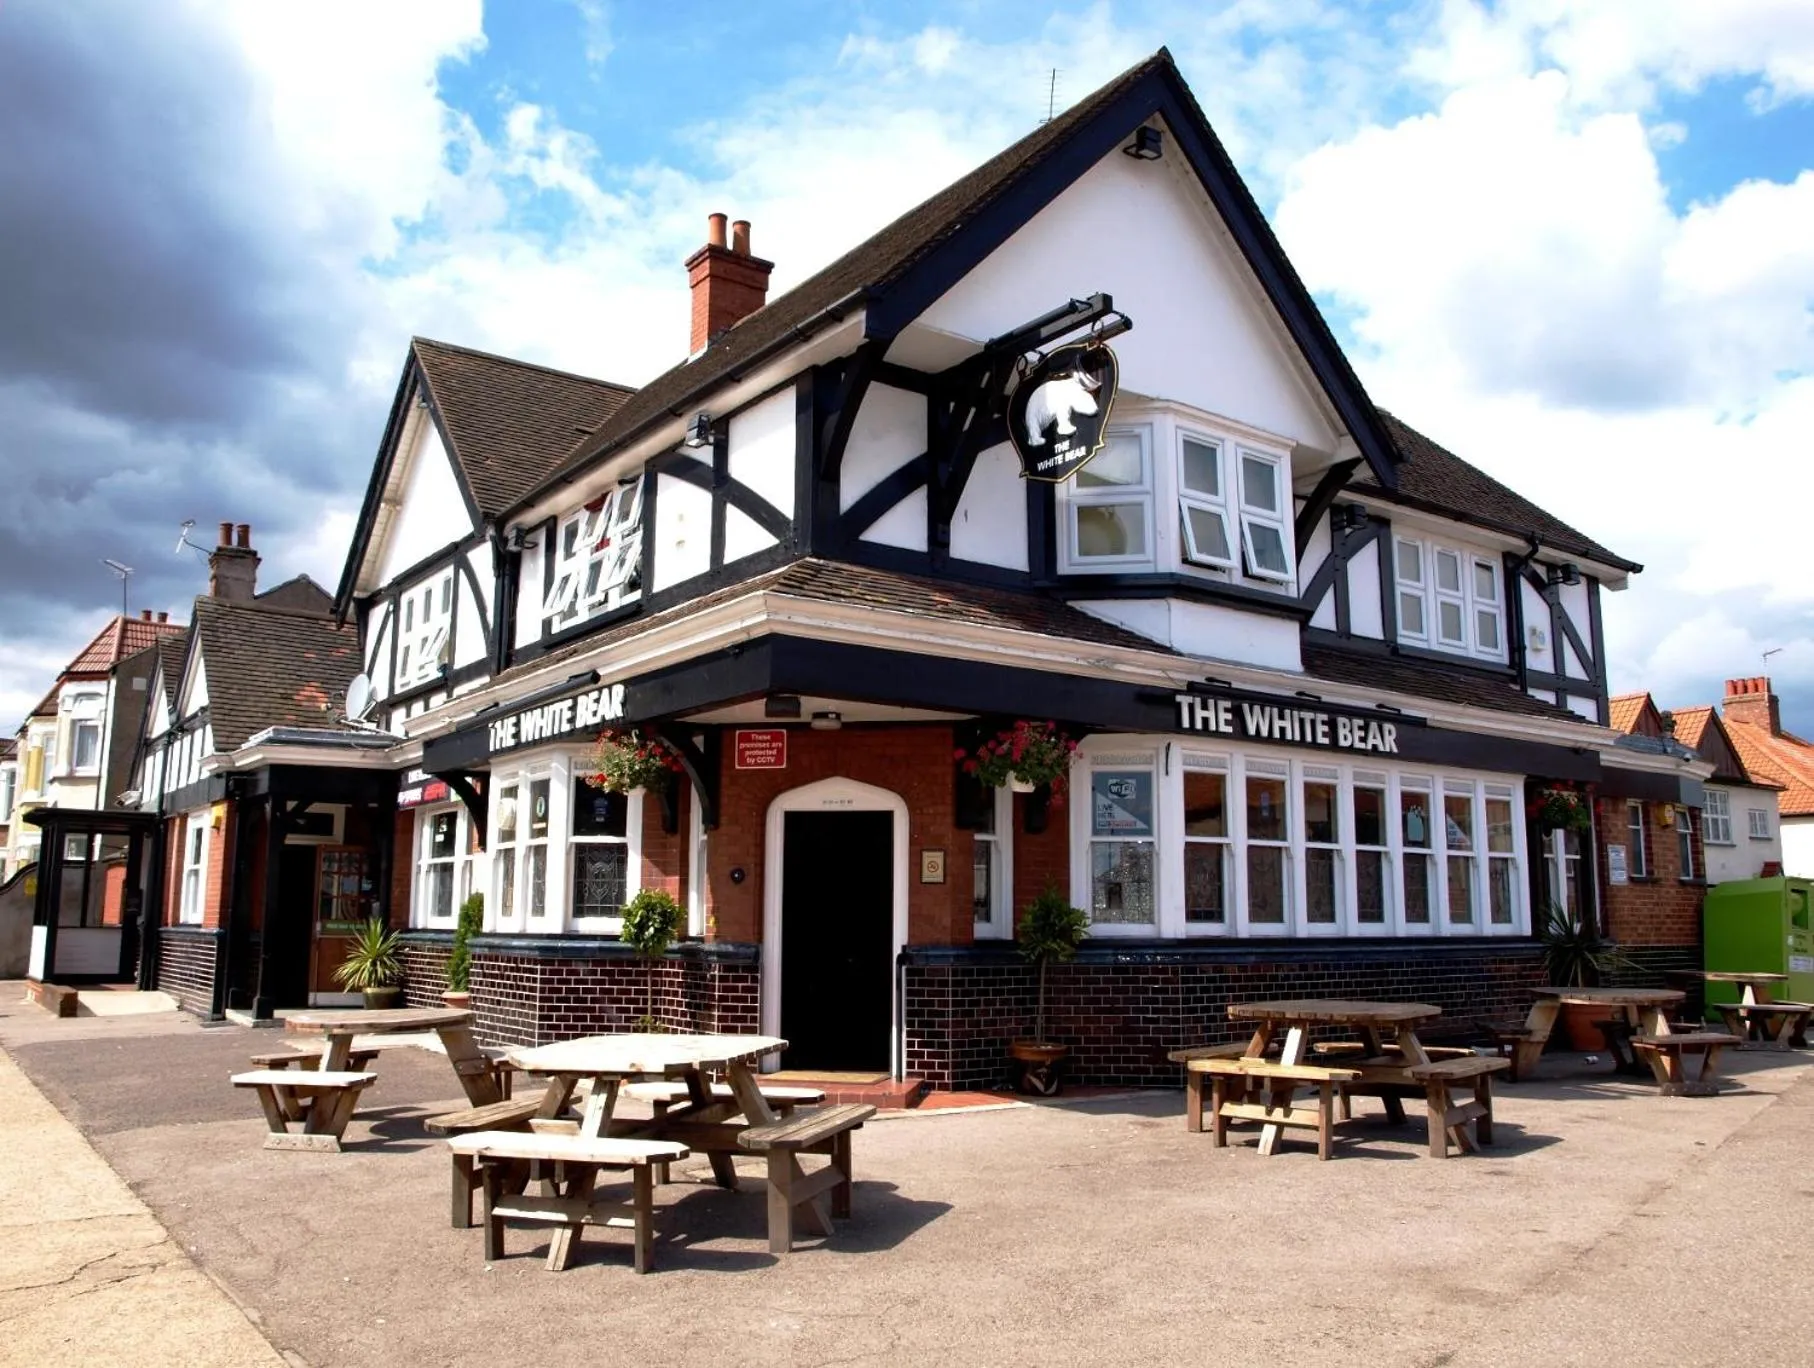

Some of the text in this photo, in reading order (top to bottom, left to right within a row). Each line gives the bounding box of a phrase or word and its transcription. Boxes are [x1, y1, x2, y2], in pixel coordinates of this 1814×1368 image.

[1054, 440, 1070, 454] THE
[1037, 446, 1086, 471] WHITE BEAR
[488, 684, 625, 752] THE WHITE BEAR
[1175, 695, 1399, 753] THE WHITE BEAR
[751, 733, 771, 741] These
[745, 749, 777, 758] protected
[746, 756, 755, 765] by
